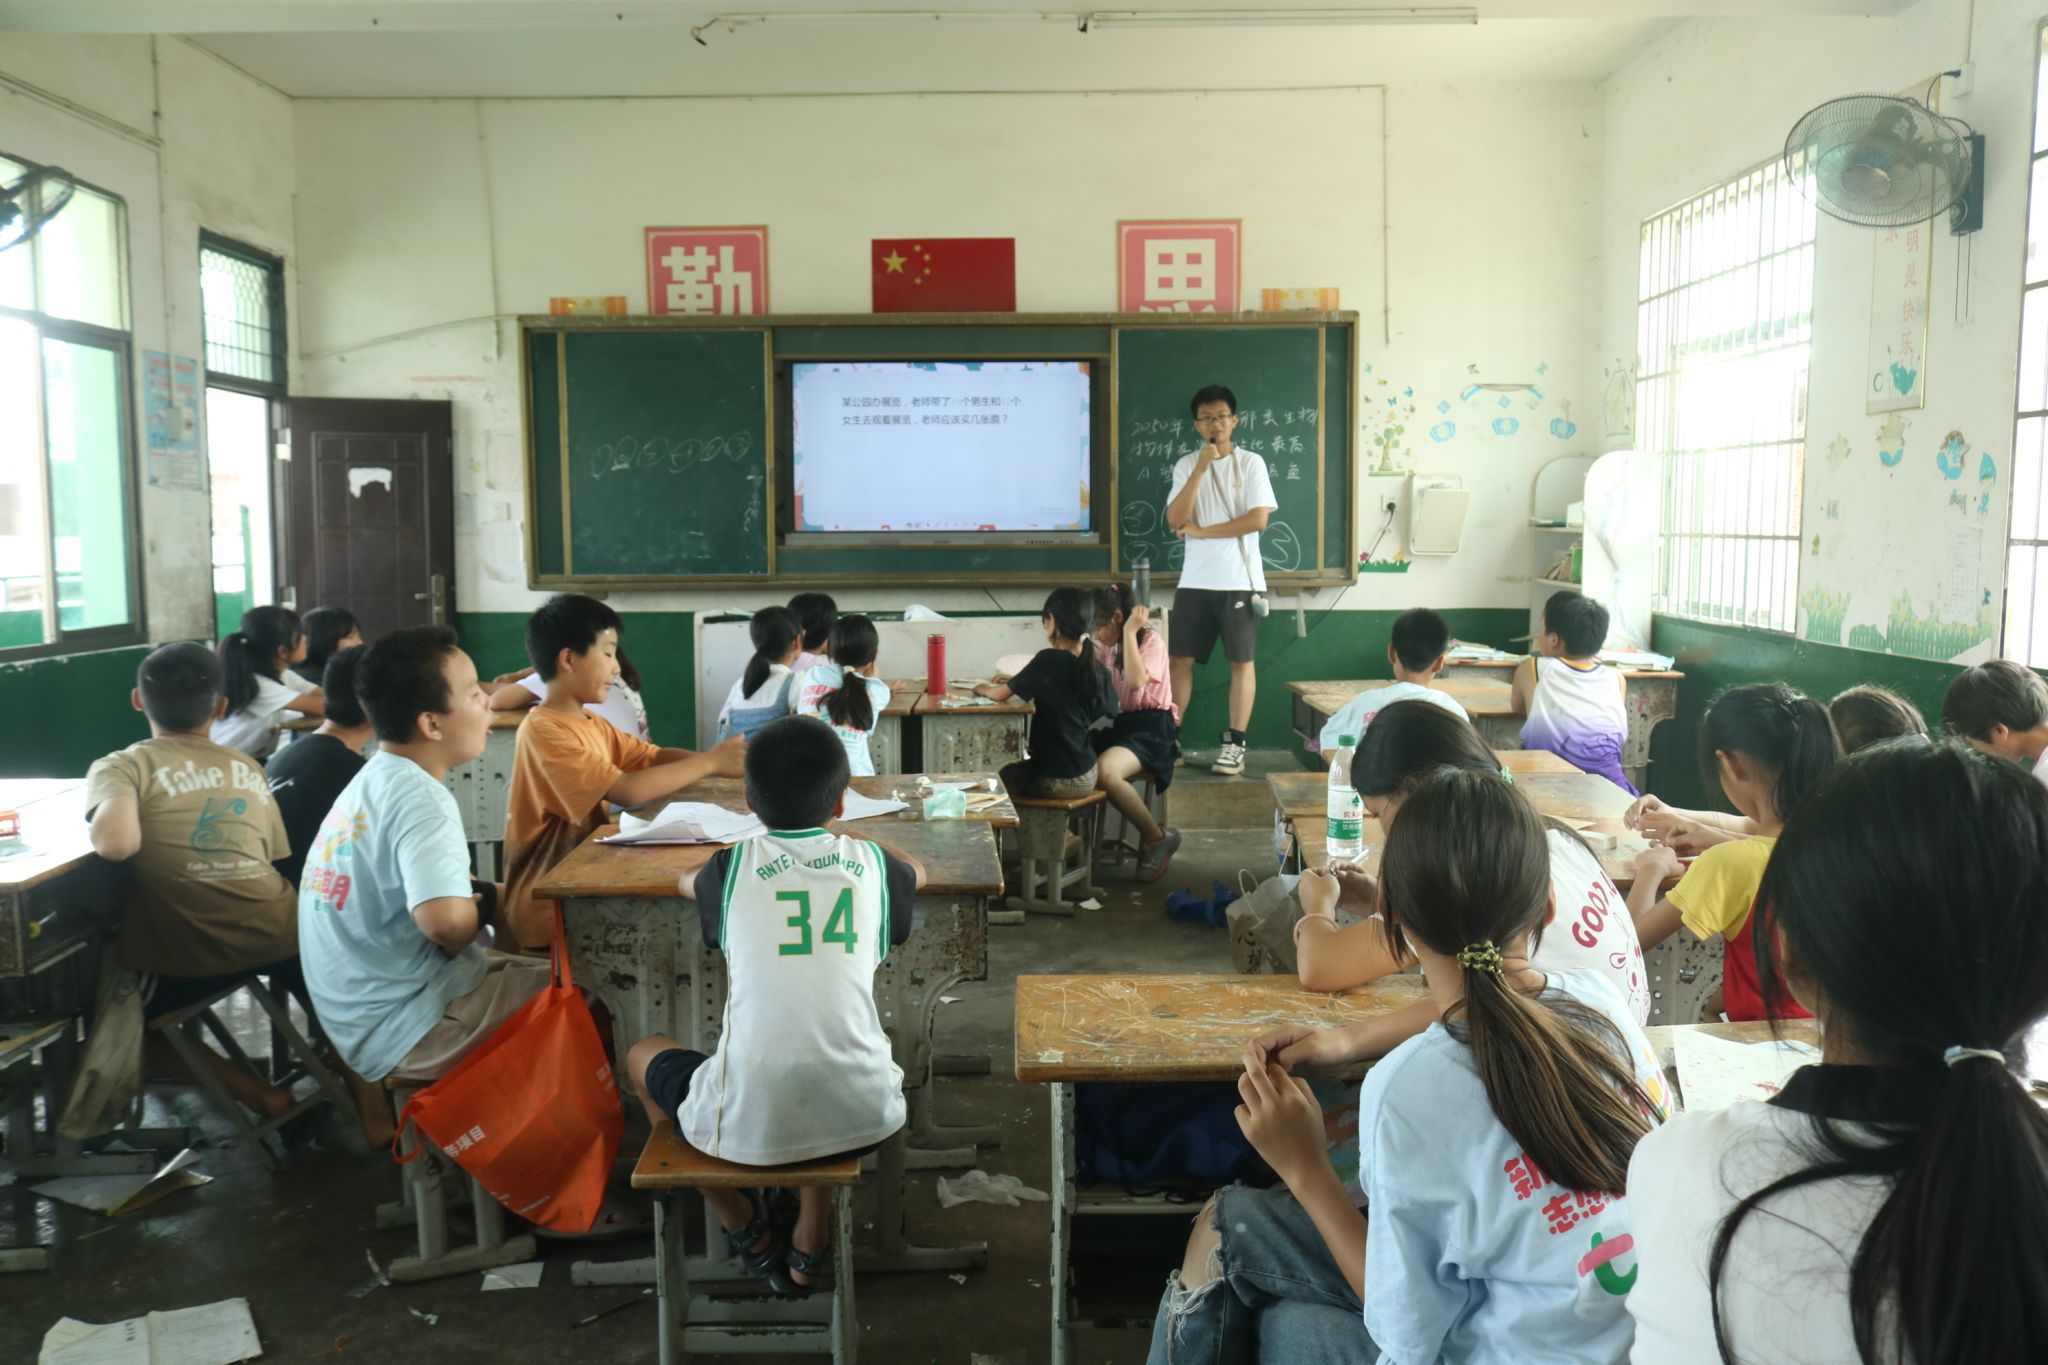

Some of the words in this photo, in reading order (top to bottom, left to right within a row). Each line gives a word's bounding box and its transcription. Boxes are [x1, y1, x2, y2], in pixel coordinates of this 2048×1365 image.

[660, 246, 752, 314] 勤
[1139, 238, 1216, 312] 思
[776, 887, 858, 956] 34
